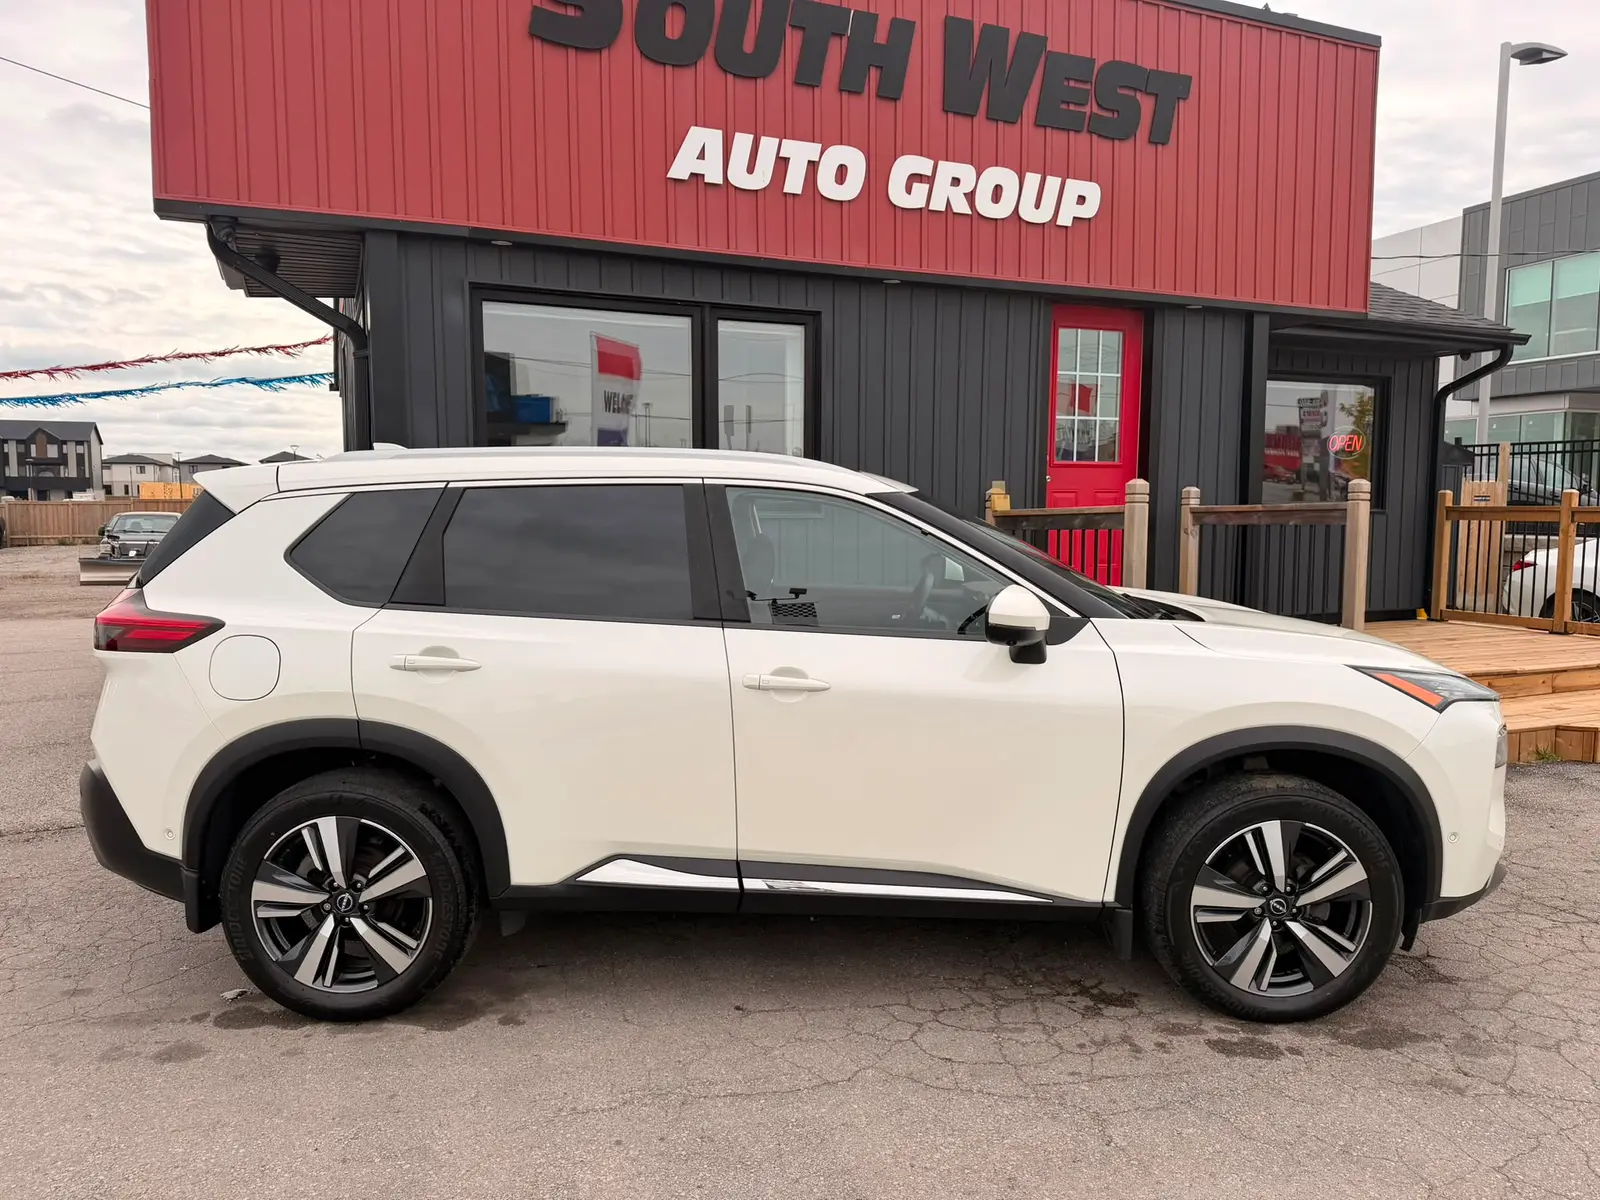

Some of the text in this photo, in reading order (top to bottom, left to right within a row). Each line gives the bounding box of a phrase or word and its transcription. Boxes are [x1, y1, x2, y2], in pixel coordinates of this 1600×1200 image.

[943, 15, 1192, 145] WEST
[667, 125, 1101, 227] AUTO GROUP
[1328, 434, 1362, 452] OPEN
